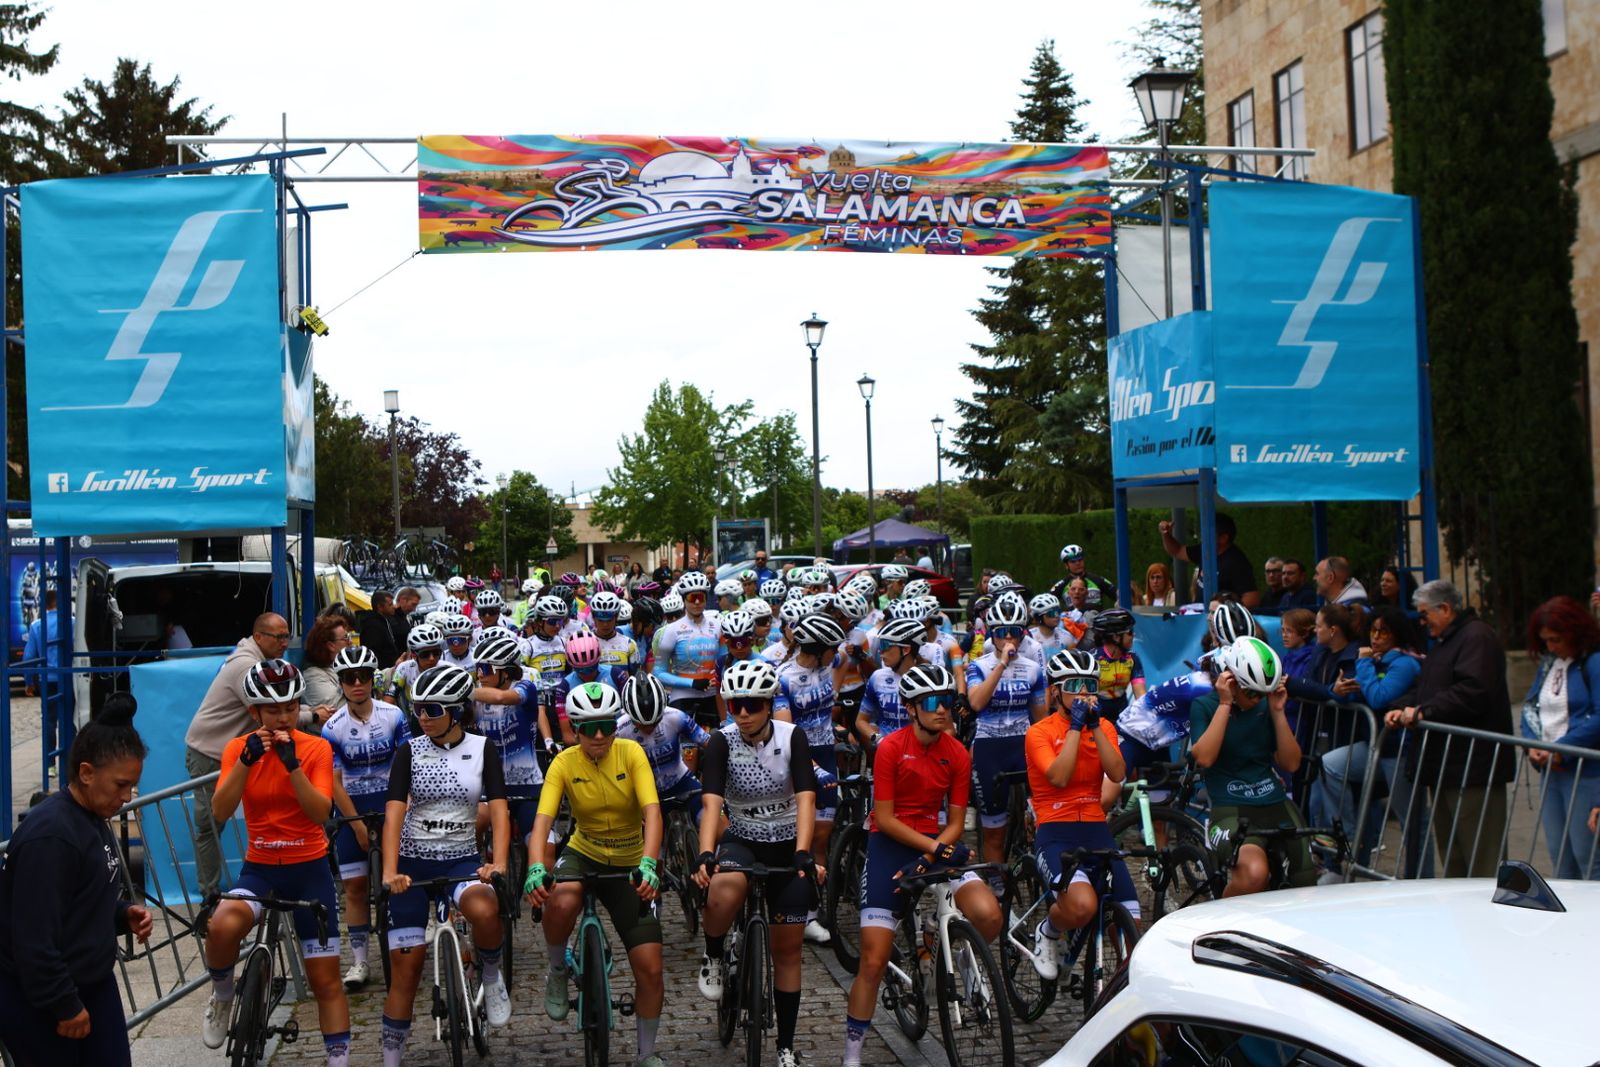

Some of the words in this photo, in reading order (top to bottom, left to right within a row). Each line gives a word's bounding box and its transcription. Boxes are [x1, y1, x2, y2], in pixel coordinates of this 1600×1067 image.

[811, 169, 912, 191] vuelta
[756, 190, 1027, 227] SALAMANCA
[823, 223, 963, 244] FÉMINAS
[1335, 444, 1409, 467] Sport
[178, 466, 272, 492] Sport
